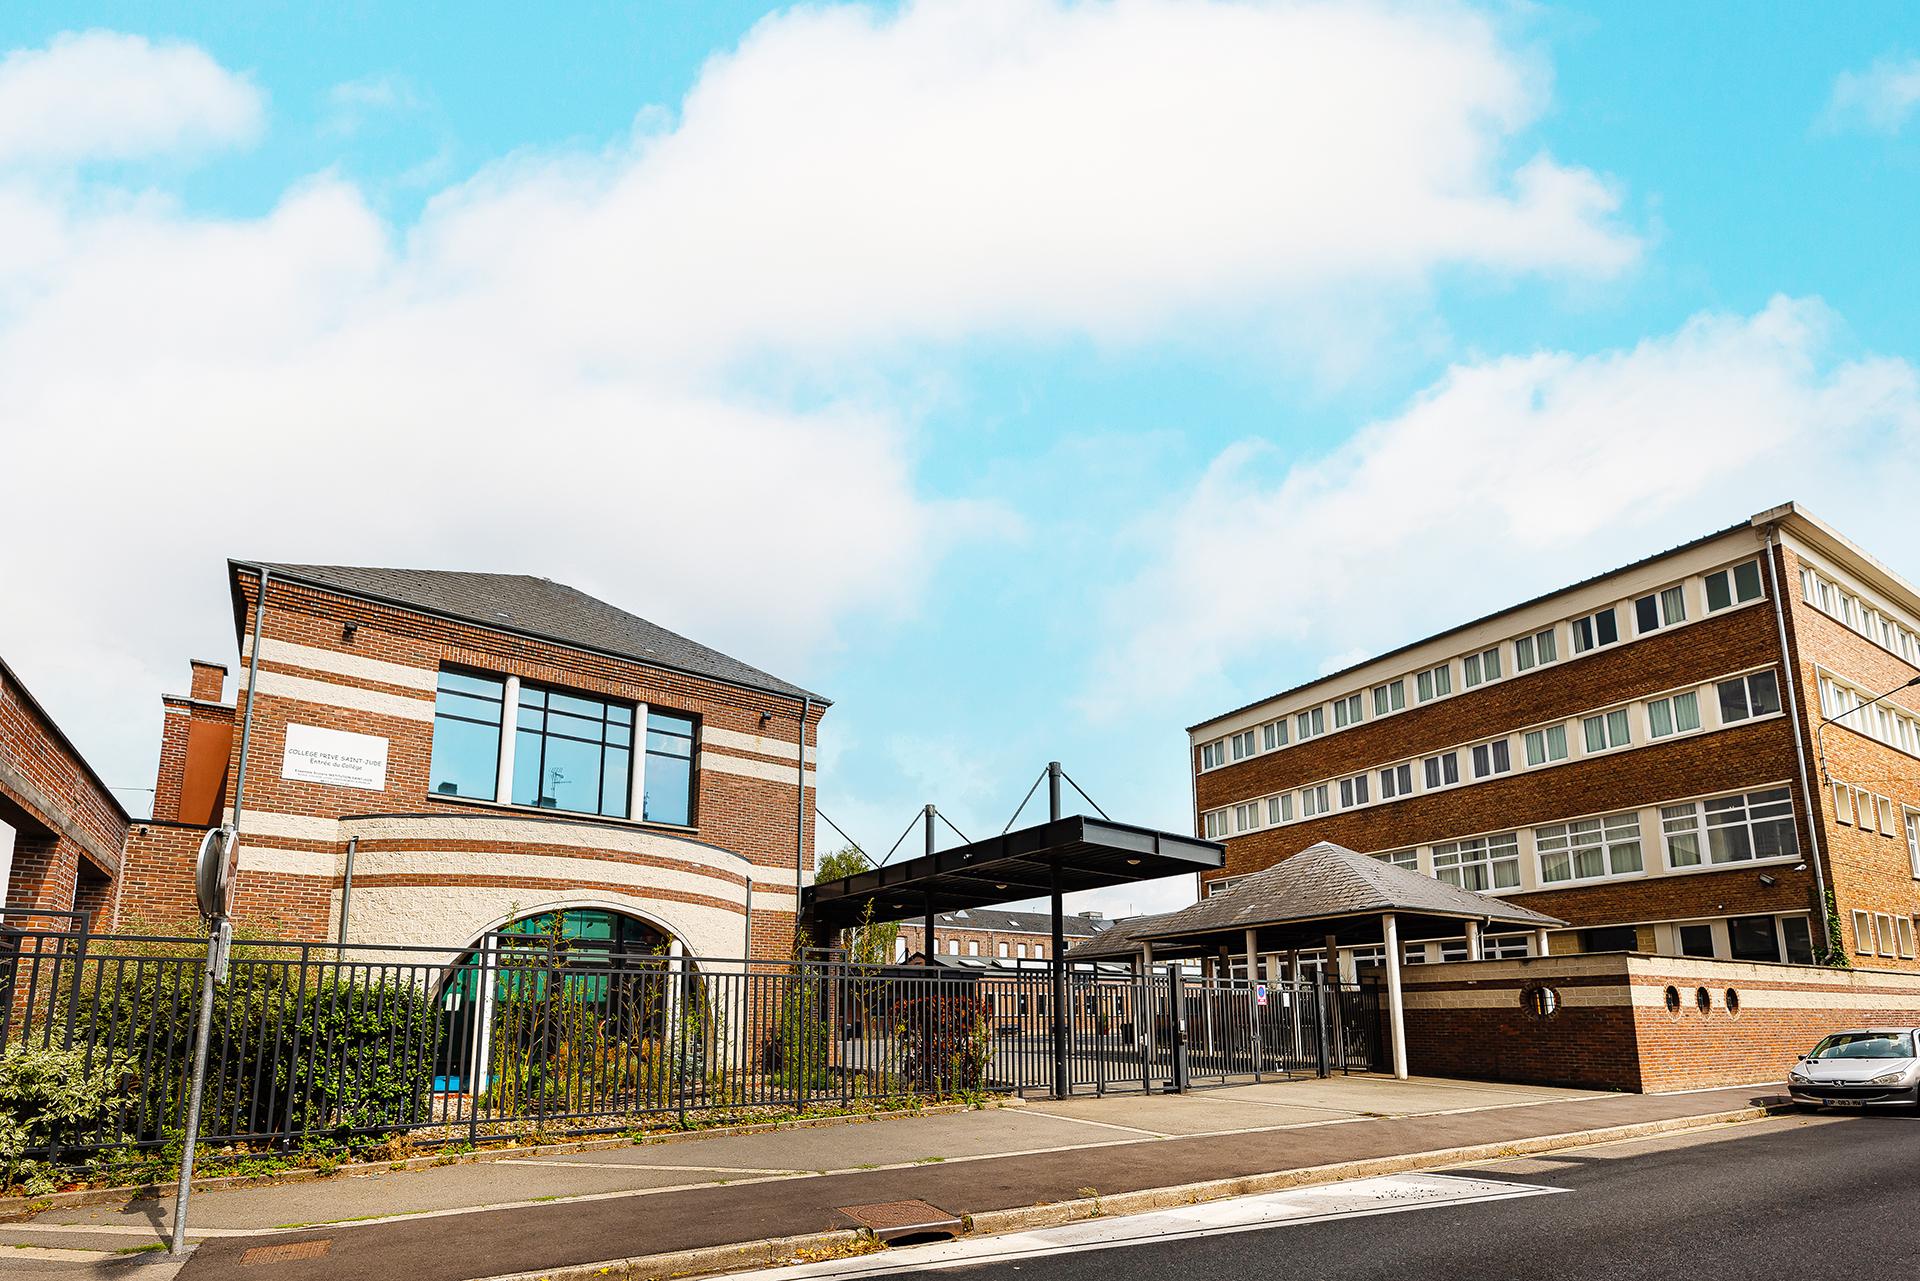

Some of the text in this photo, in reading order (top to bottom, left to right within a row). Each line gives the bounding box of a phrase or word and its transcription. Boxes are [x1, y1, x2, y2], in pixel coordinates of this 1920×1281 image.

[309, 757, 331, 767] Entrée
[341, 762, 363, 771] Collège
[340, 755, 382, 767] SAINT-JUDE
